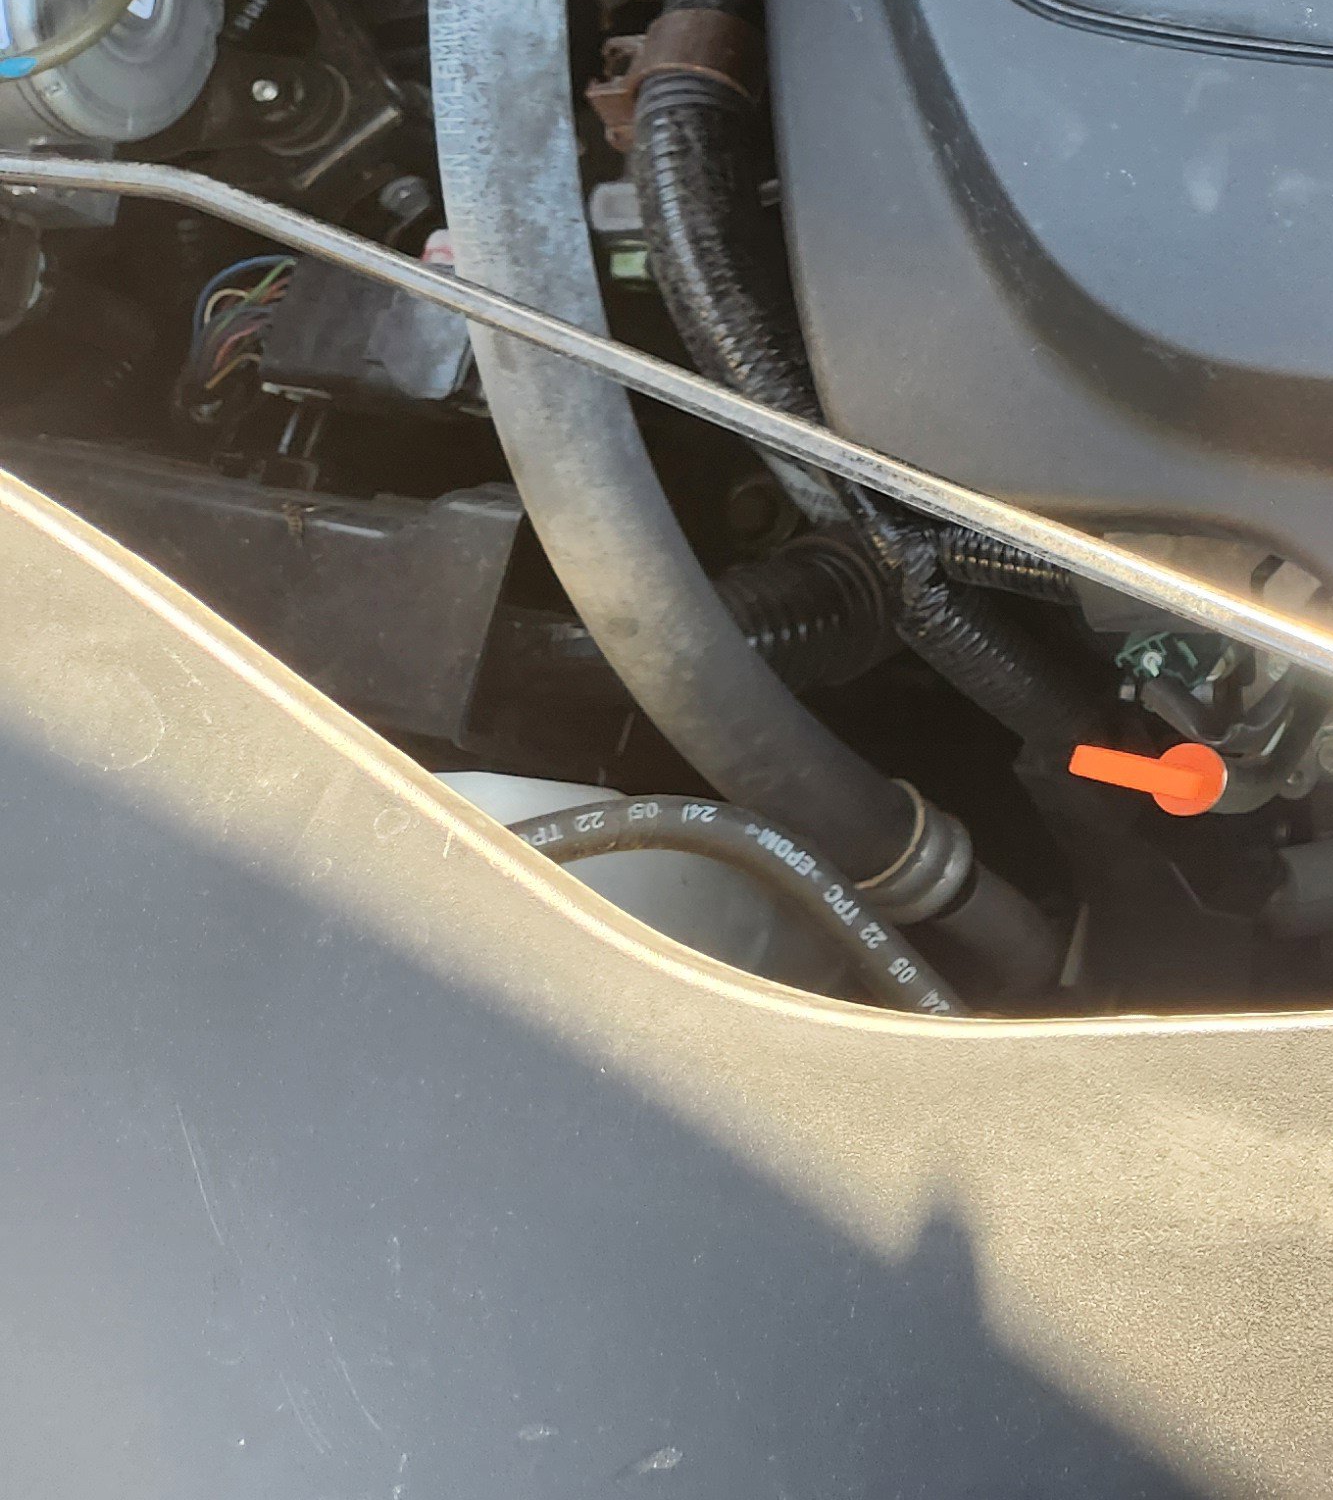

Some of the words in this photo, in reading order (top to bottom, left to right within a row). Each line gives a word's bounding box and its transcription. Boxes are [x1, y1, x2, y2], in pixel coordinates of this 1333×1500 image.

[574, 810, 605, 833] 22
[822, 883, 861, 927] TPC
[859, 921, 888, 950] 22
